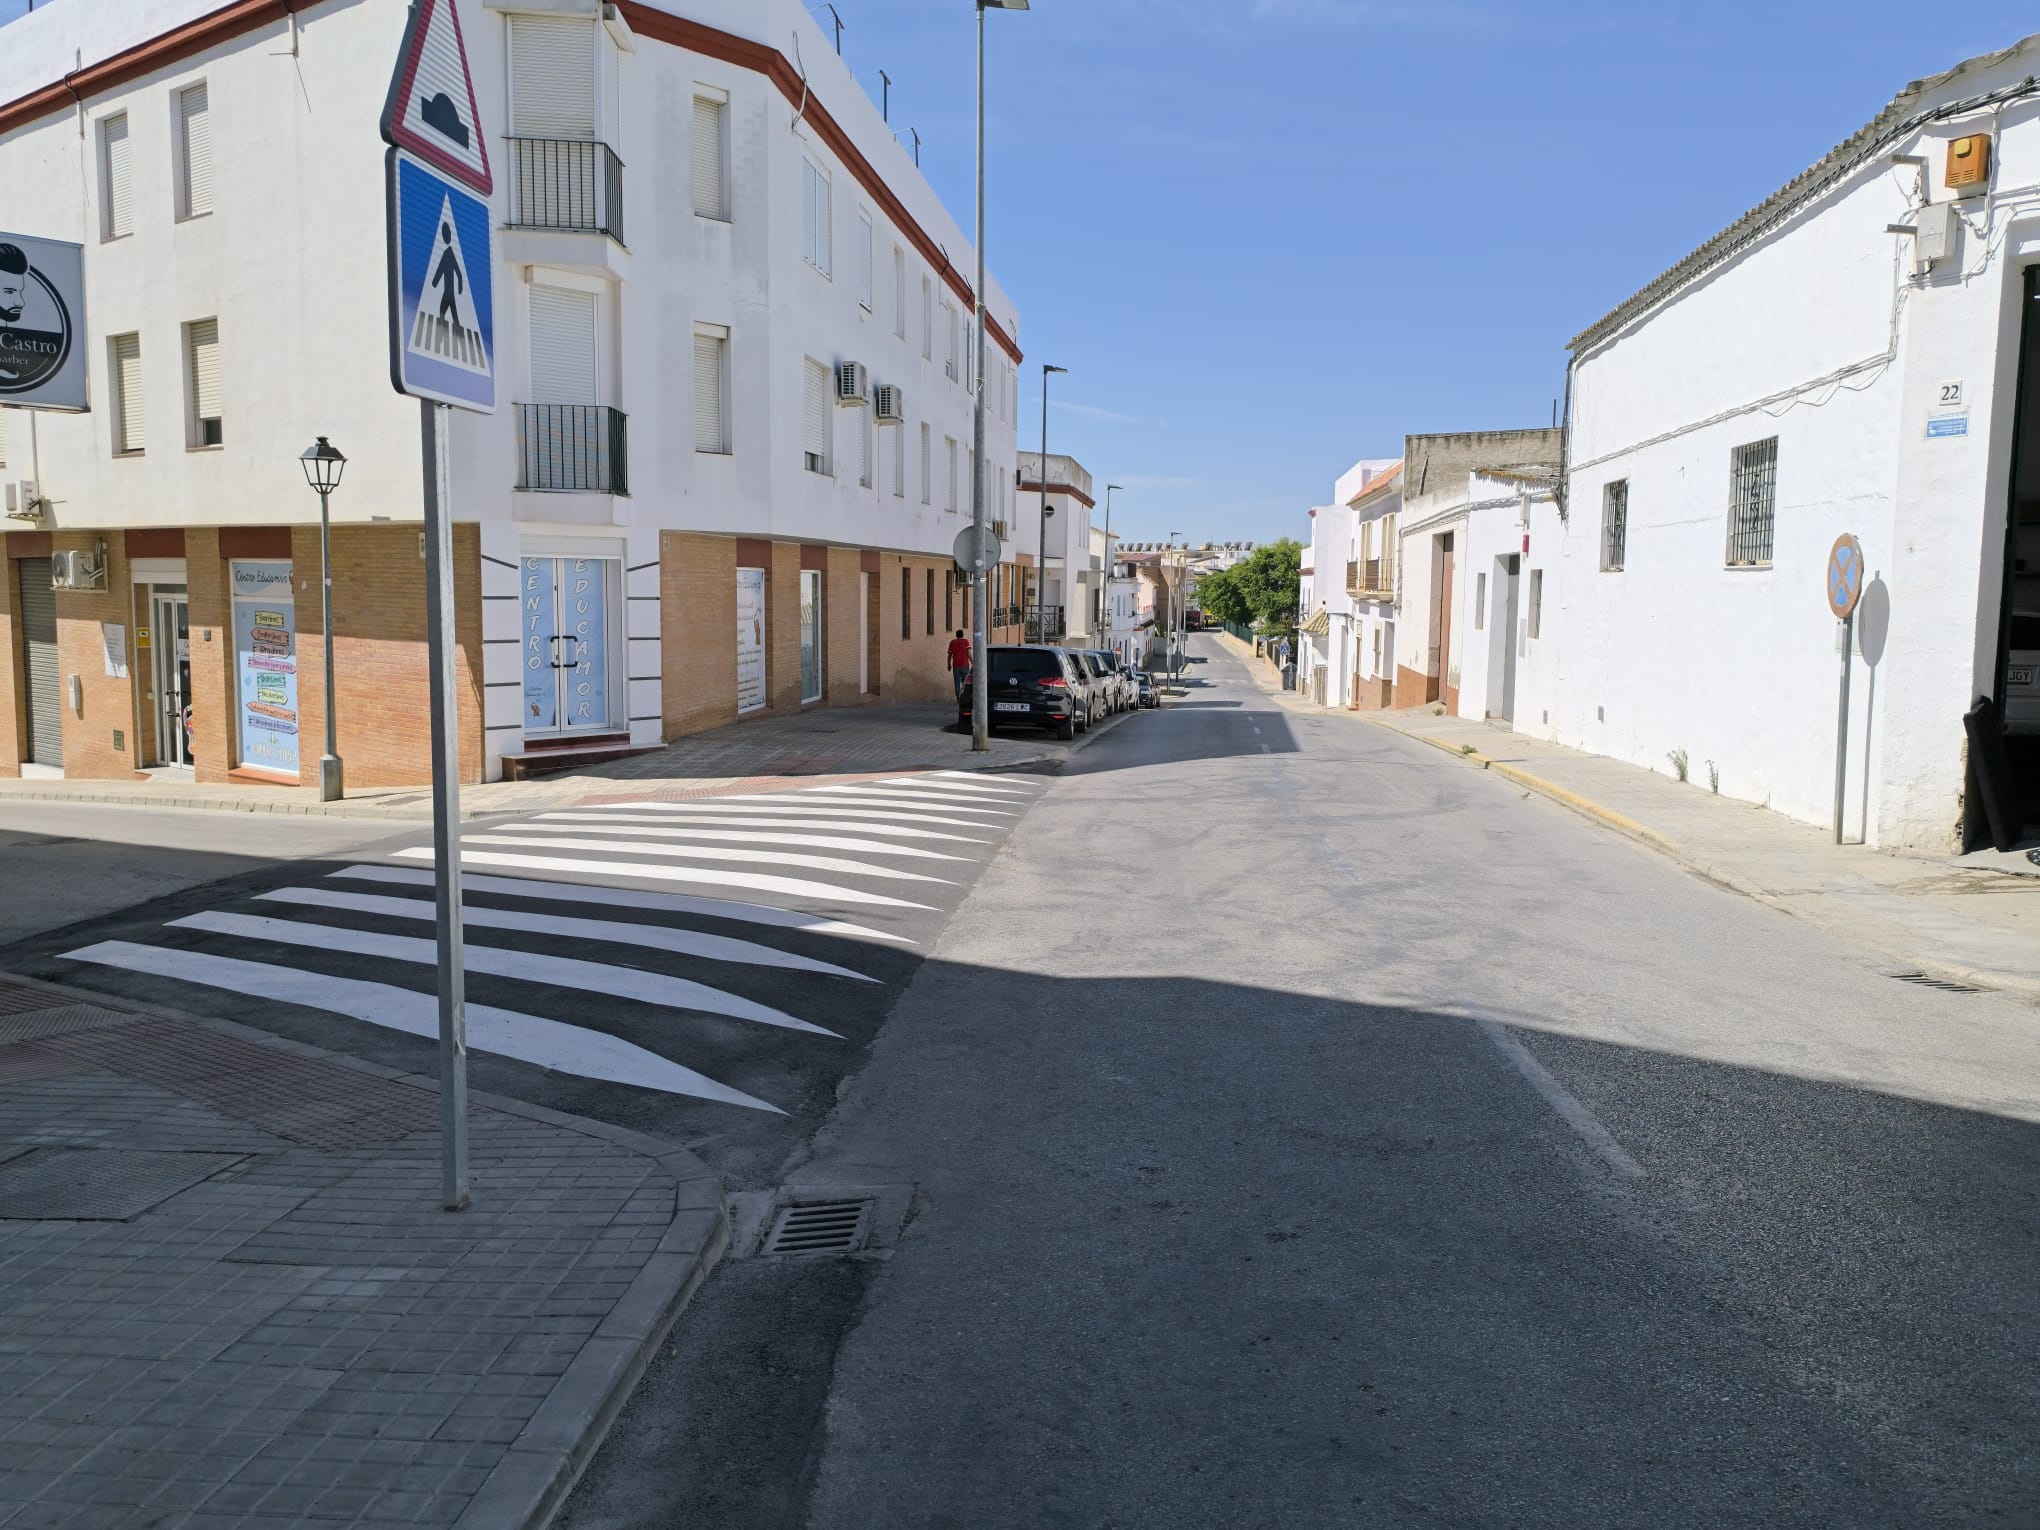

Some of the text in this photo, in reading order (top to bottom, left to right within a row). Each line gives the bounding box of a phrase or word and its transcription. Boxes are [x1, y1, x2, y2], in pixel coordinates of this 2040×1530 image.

[0, 332, 57, 354] Castro
[1941, 385, 1959, 401] 22
[526, 557, 542, 670] CENTRO
[574, 559, 592, 718] EDUCAMOR
[2009, 671, 2029, 681] JGY
